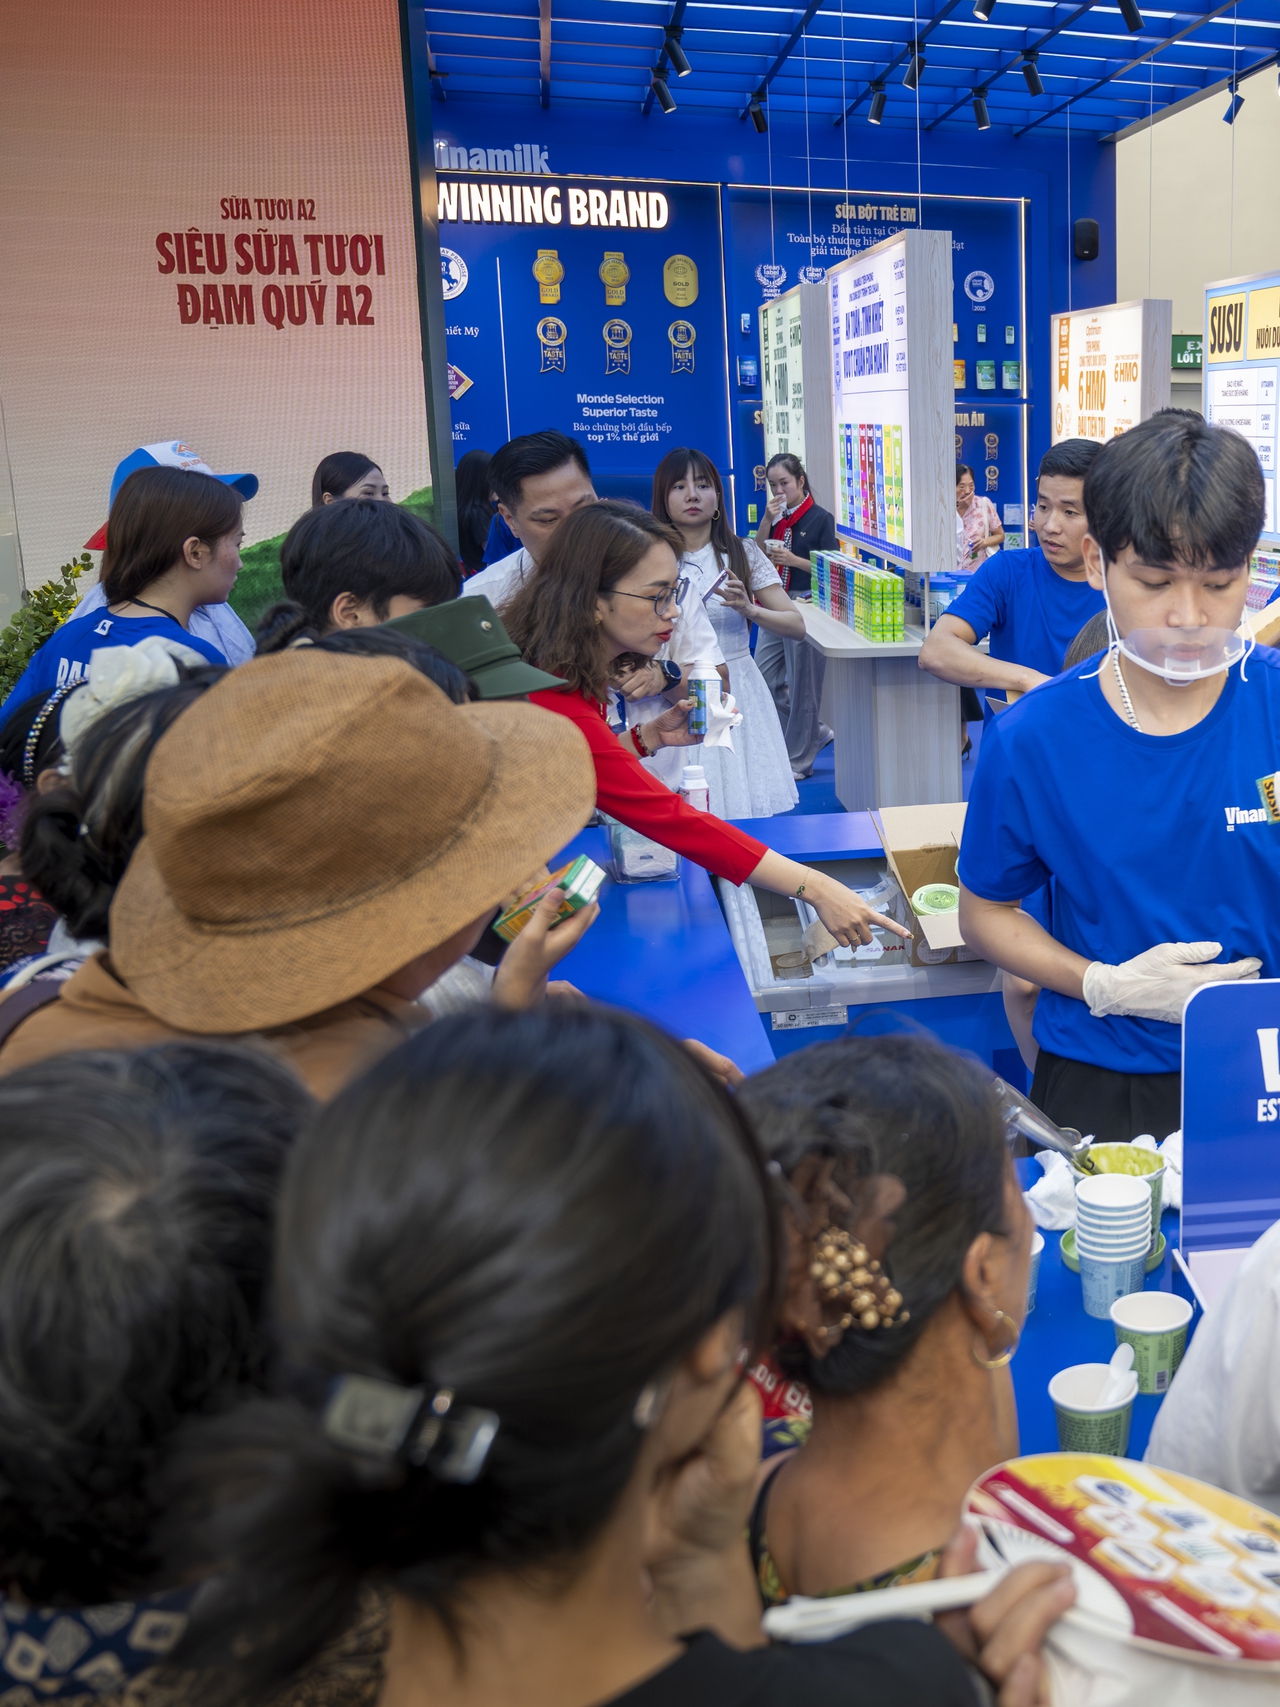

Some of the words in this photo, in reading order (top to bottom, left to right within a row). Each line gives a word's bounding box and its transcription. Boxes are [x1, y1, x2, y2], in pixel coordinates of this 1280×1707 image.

[433, 138, 552, 173] inamilk
[220, 195, 252, 220] SỮA
[254, 198, 294, 220] TƯƠI
[298, 199, 316, 220] A2
[437, 182, 562, 224] WINNING
[568, 188, 669, 229] BRAND
[858, 203, 879, 222] BỘT
[900, 207, 917, 222] EM
[787, 233, 811, 243] Toàn
[853, 225, 872, 235] tiên
[156, 226, 228, 276] SIÊU
[234, 228, 300, 276] SỮA
[304, 234, 386, 276] TƯƠI
[176, 284, 256, 330] ĐẠM
[262, 279, 328, 331] QUÝ
[336, 284, 375, 326] A2
[1210, 302, 1243, 354] SUSU
[674, 352, 692, 360] TASTE
[1177, 350, 1194, 363] LỐI
[1114, 363, 1119, 382] 6
[1120, 362, 1139, 382] HMO
[576, 394, 614, 404] Monde
[615, 394, 664, 404] Selection
[1078, 371, 1083, 411] 6
[1086, 370, 1106, 411] HMO
[582, 407, 628, 418] Superior
[629, 408, 658, 417] Taste
[587, 434, 604, 443] top
[606, 433, 620, 441] 1%
